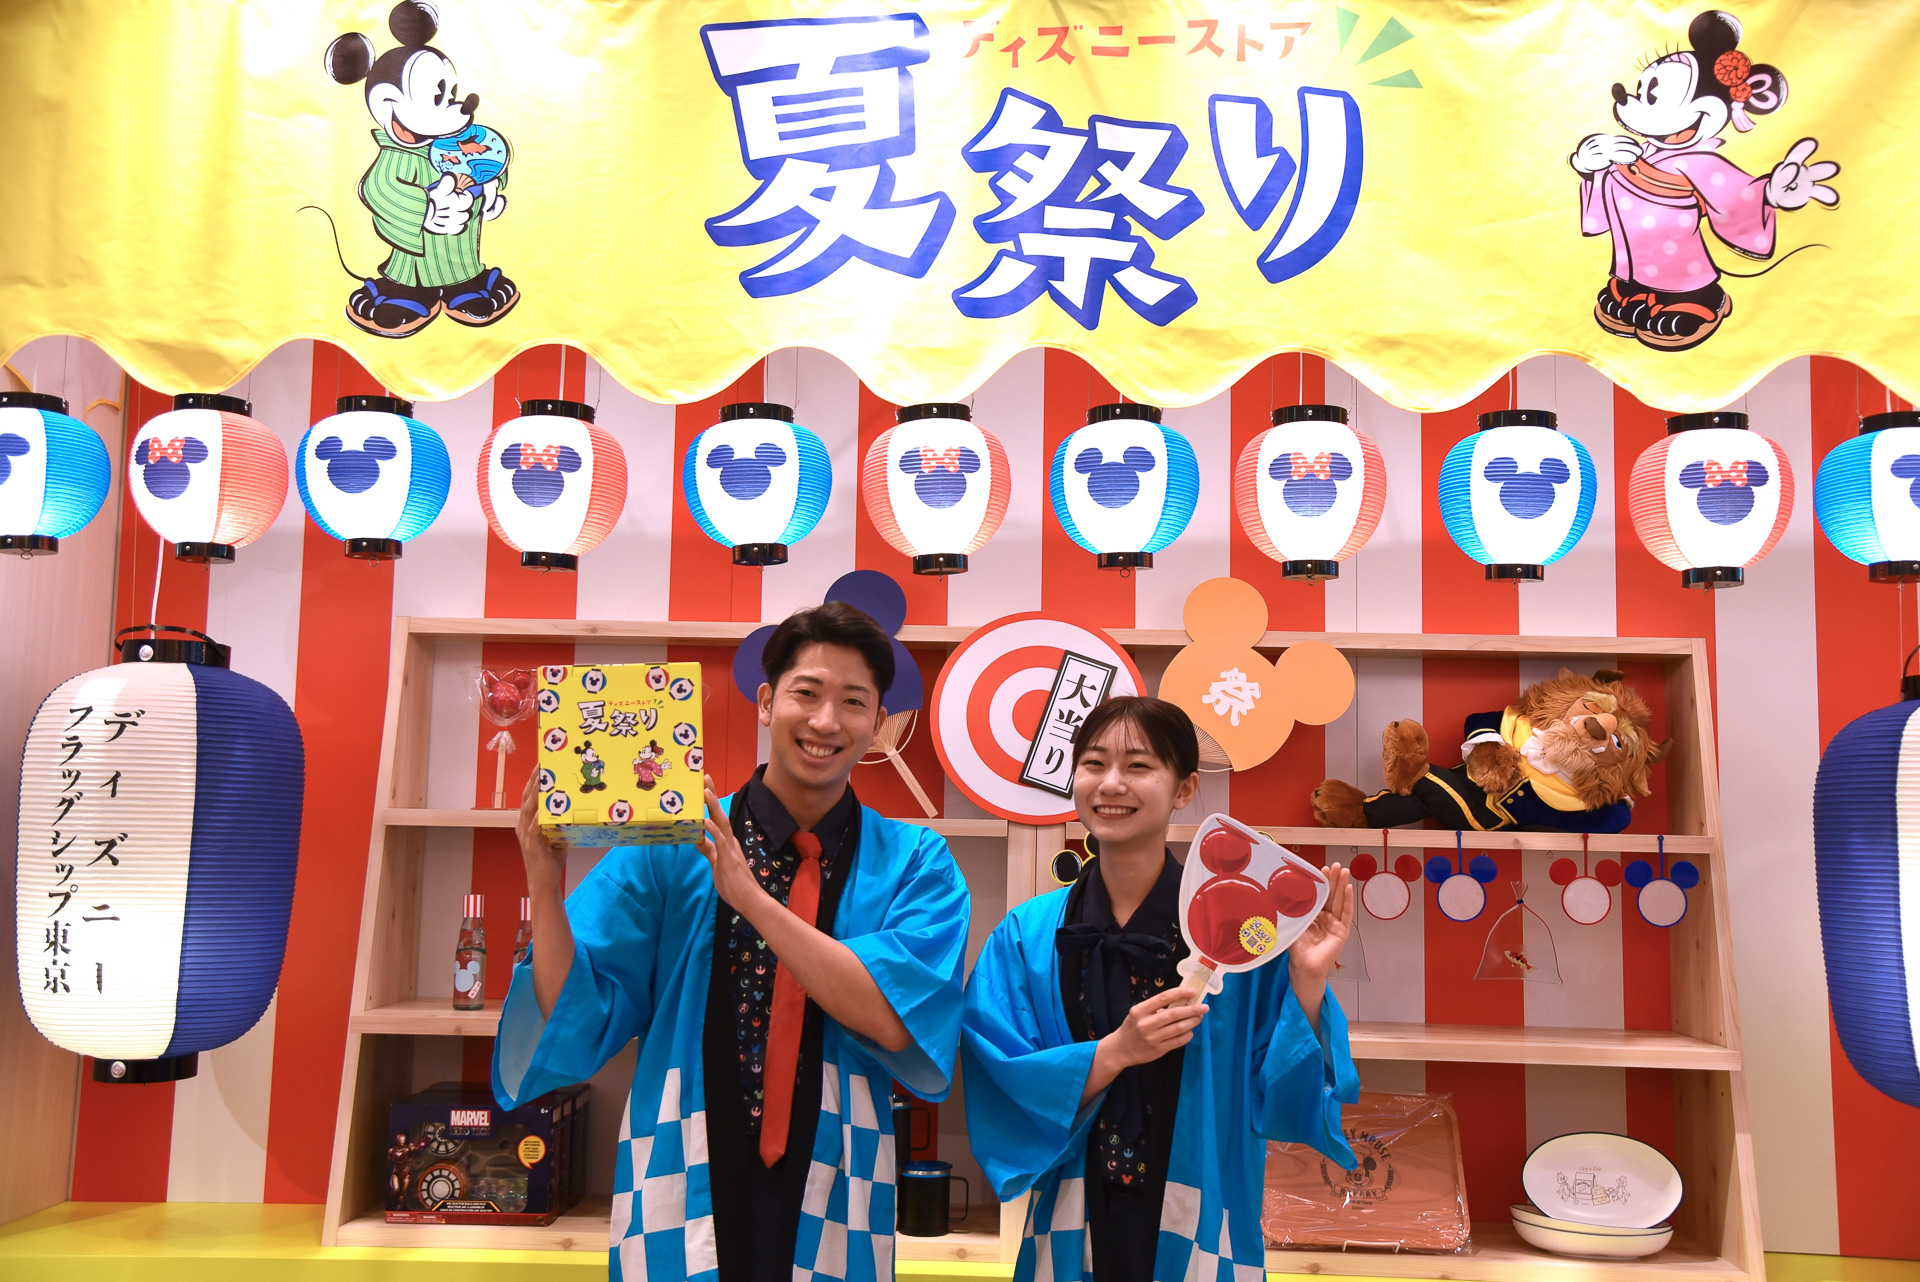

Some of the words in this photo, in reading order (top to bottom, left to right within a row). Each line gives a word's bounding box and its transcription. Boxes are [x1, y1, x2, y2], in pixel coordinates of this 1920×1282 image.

[962, 18, 1312, 69] ディズニーストア
[700, 12, 1364, 331] 夏祭り
[577, 699, 659, 738] 夏祭り
[1043, 673, 1097, 775] 大当り
[1201, 666, 1262, 727] 祭
[43, 705, 94, 994] フラッグシップ東京
[82, 708, 146, 995] ディズニー
[450, 1110, 489, 1126] MARVEL
[1360, 1131, 1392, 1161] MOUSE
